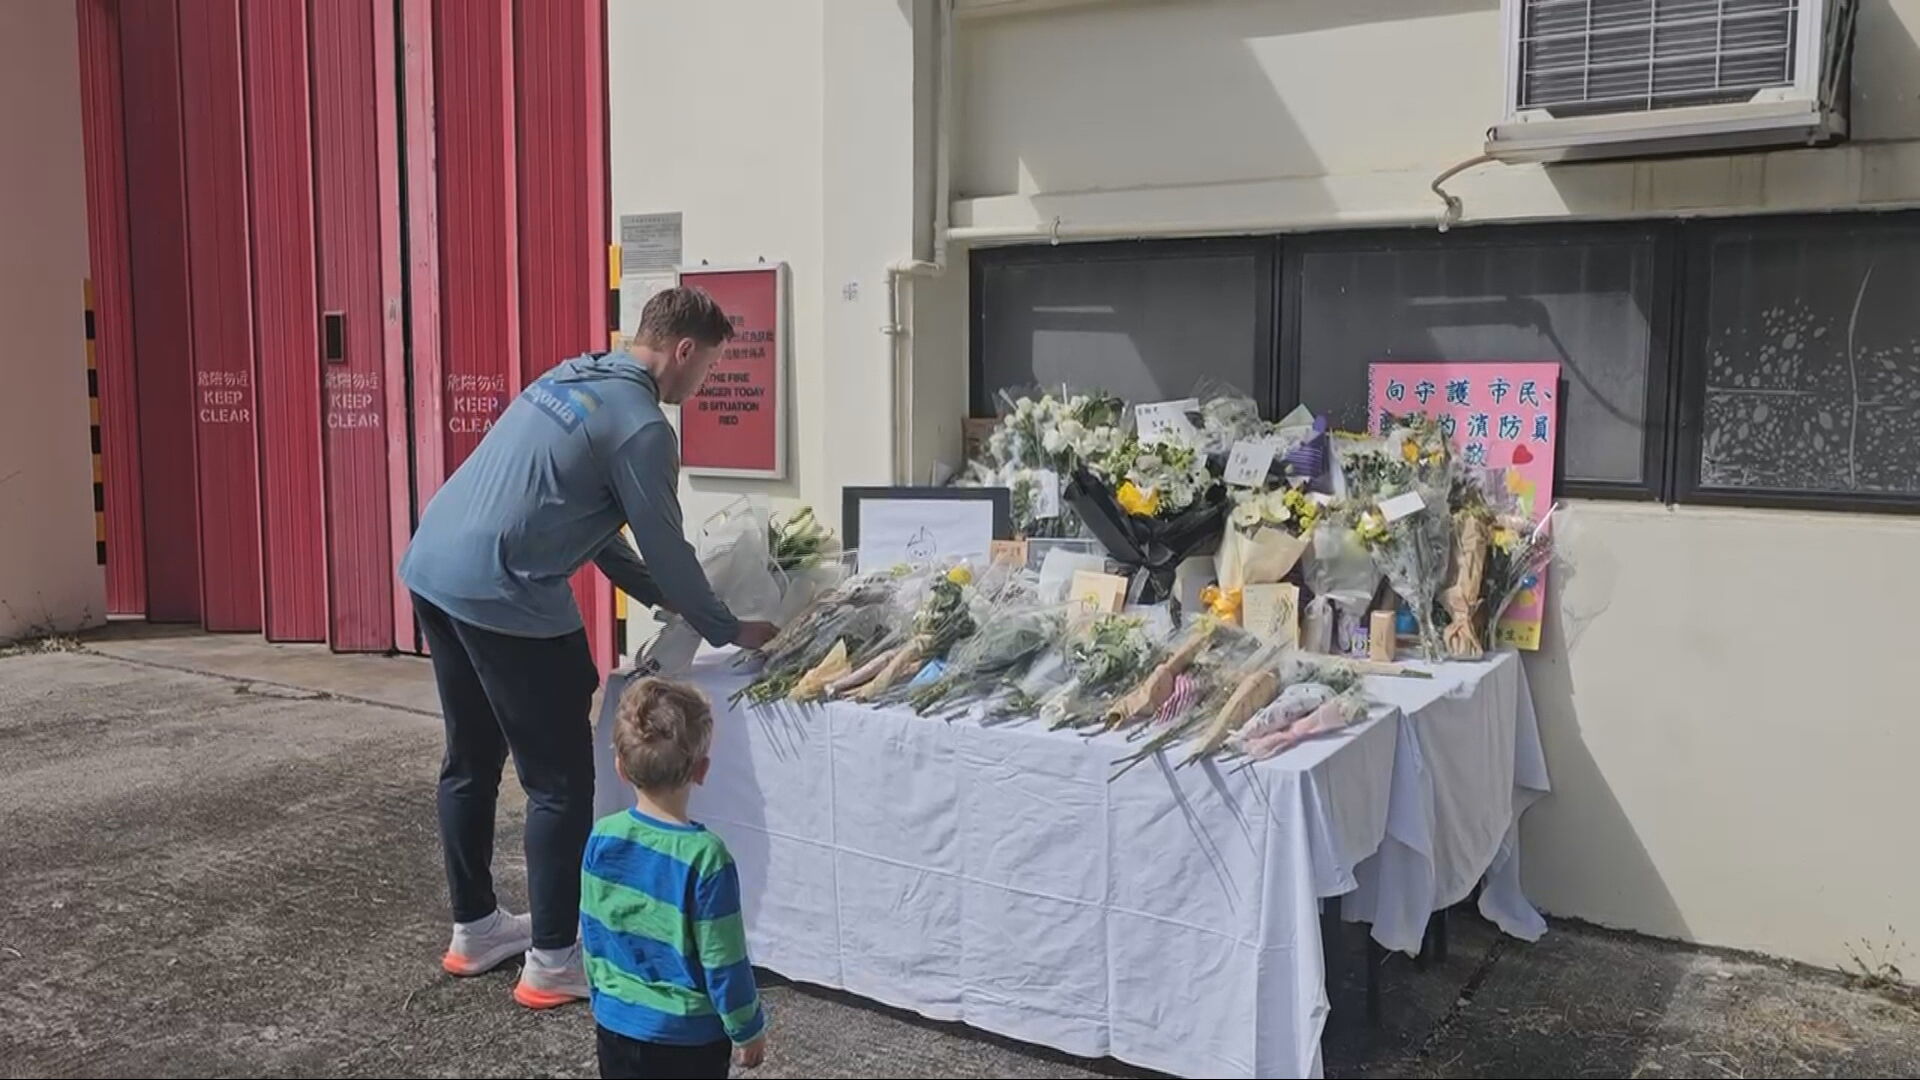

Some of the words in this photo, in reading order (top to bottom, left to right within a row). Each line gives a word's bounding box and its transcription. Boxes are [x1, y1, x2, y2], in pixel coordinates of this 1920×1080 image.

[727, 373, 750, 383] FIRE
[203, 390, 243, 405] KEEP
[734, 387, 765, 397] TODAY
[331, 393, 372, 409] KEEP
[453, 396, 499, 413] KEEP
[698, 402, 709, 412] IS
[710, 401, 760, 412] SITUATION
[200, 408, 250, 423] CLEAR
[327, 412, 380, 428] CLEAR
[718, 416, 739, 426] RED
[449, 417, 495, 433] CLEA
